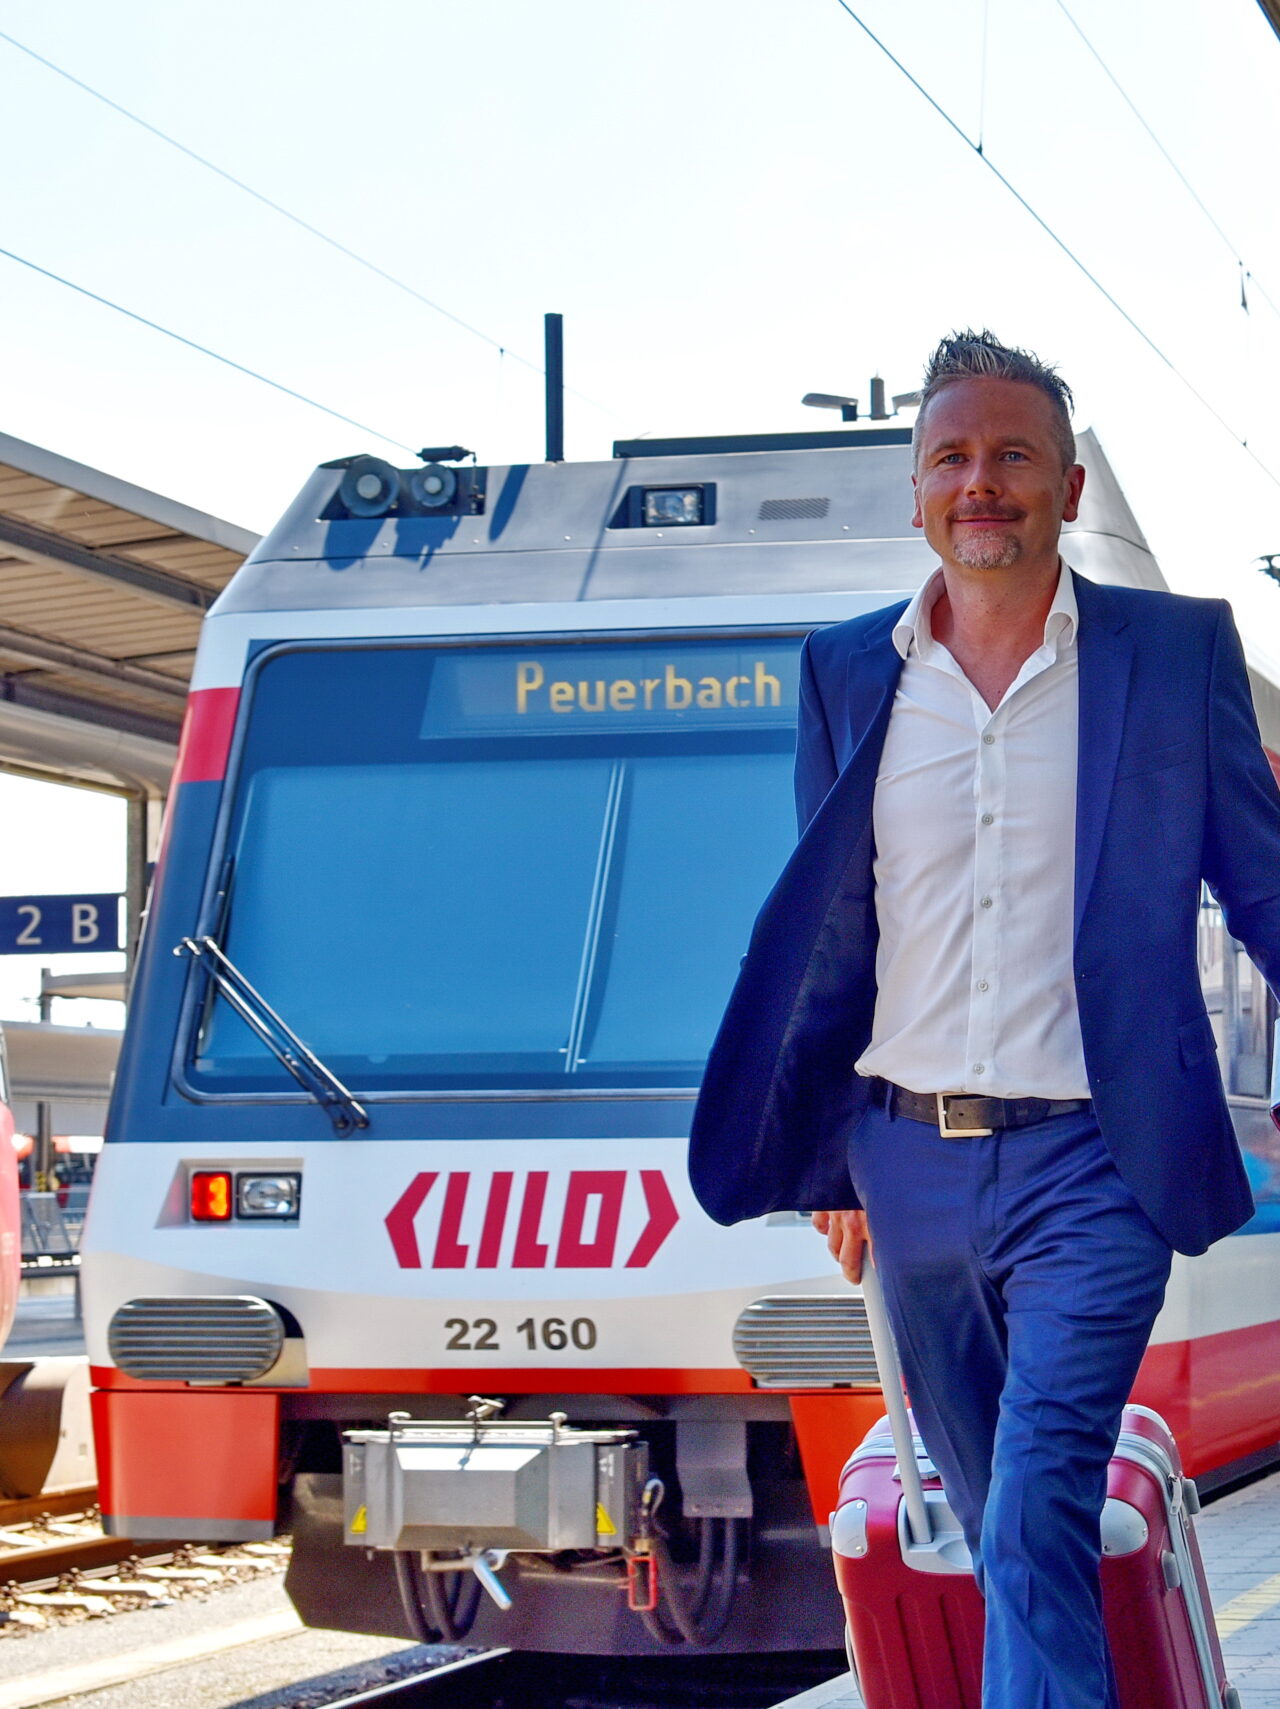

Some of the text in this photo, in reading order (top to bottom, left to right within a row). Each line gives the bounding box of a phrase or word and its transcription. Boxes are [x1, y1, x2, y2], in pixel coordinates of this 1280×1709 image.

[516, 662, 781, 713] Peuerbach
[17, 904, 99, 945] 2 B
[432, 1170, 628, 1269] LILO
[444, 1317, 597, 1351] 22 160
